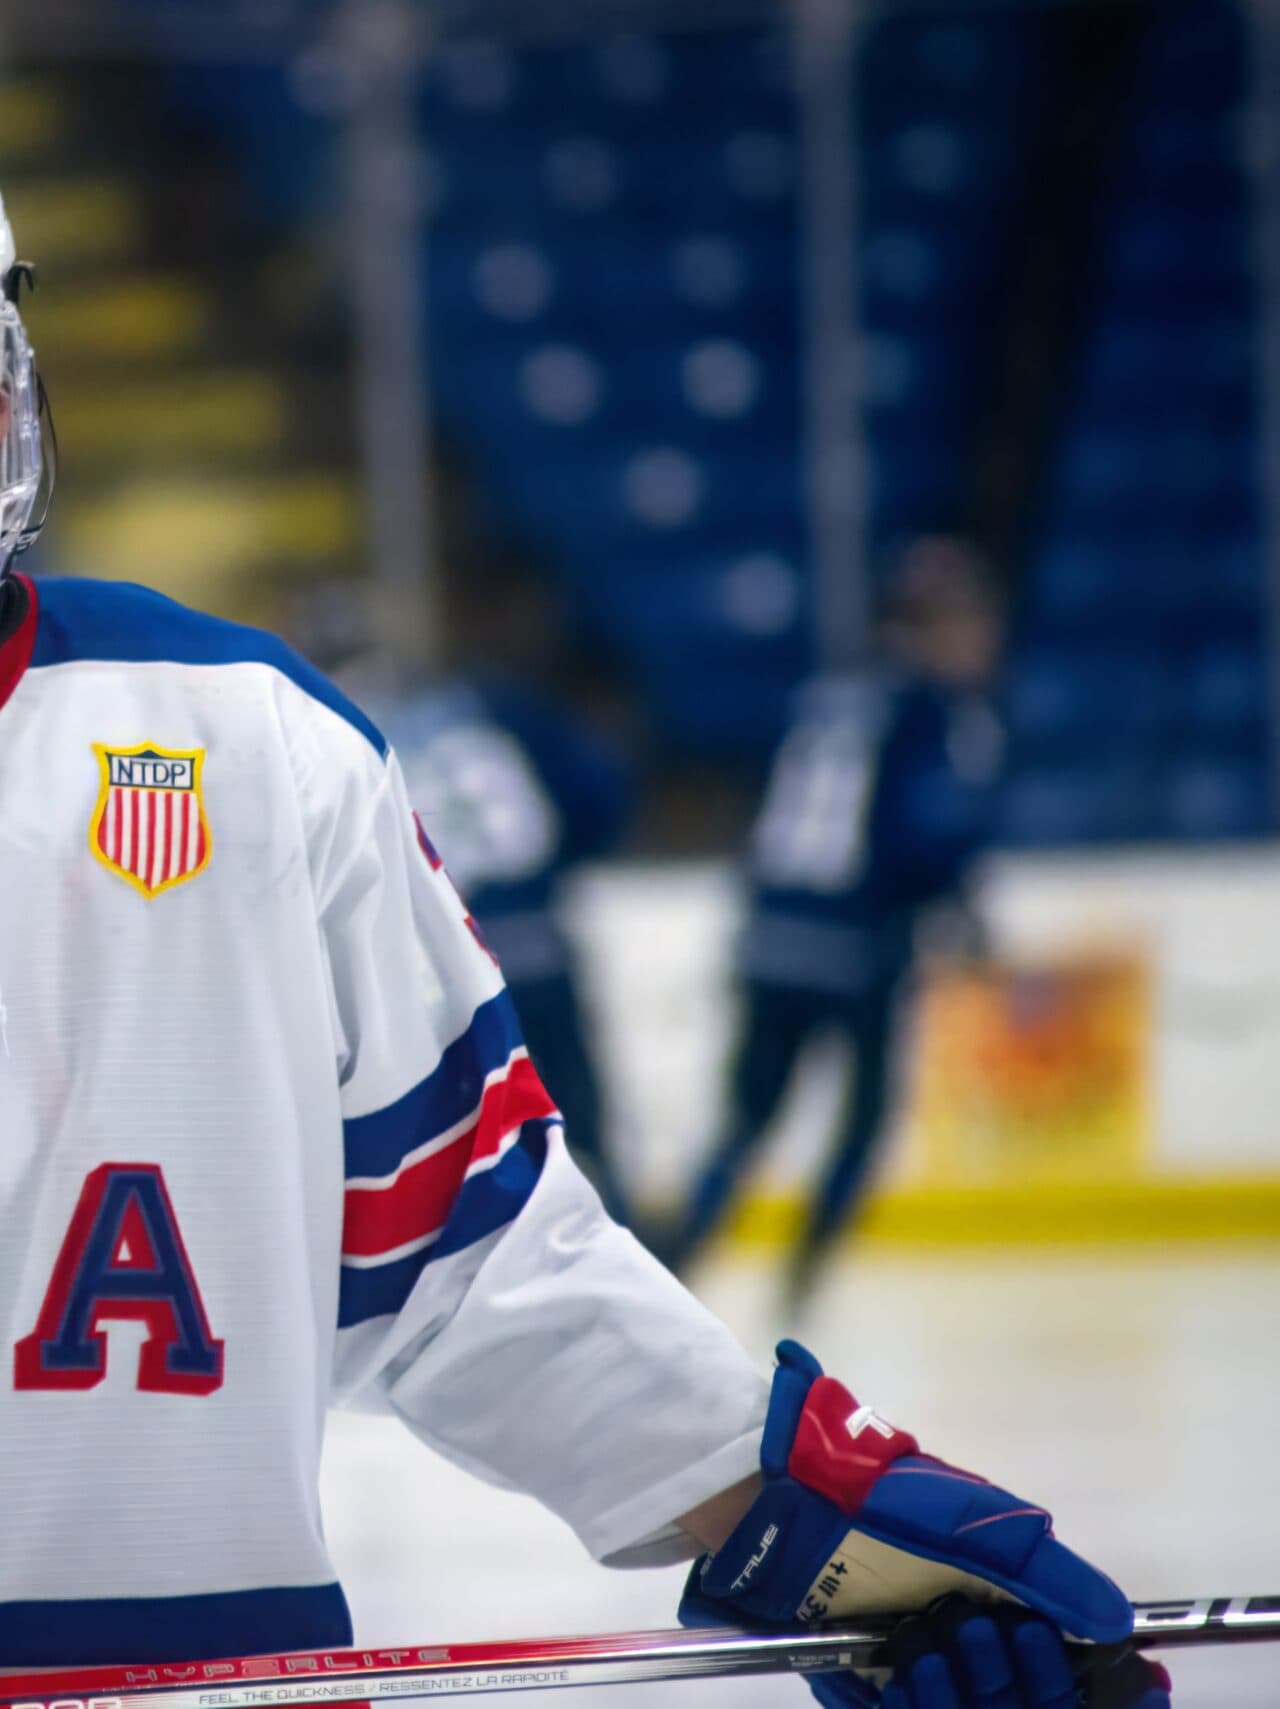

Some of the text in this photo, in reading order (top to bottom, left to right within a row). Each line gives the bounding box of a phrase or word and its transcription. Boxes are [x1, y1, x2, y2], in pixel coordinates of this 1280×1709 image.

[117, 759, 187, 785] NTDP
[730, 1523, 779, 1590] TRUE
[125, 1649, 452, 1683] HYPERLITE
[199, 1693, 239, 1705] FEEL
[242, 1690, 275, 1702] THE
[277, 1683, 365, 1700] QUICKNESS
[379, 1676, 472, 1693] RESSENTEZ
[476, 1674, 498, 1686] LA
